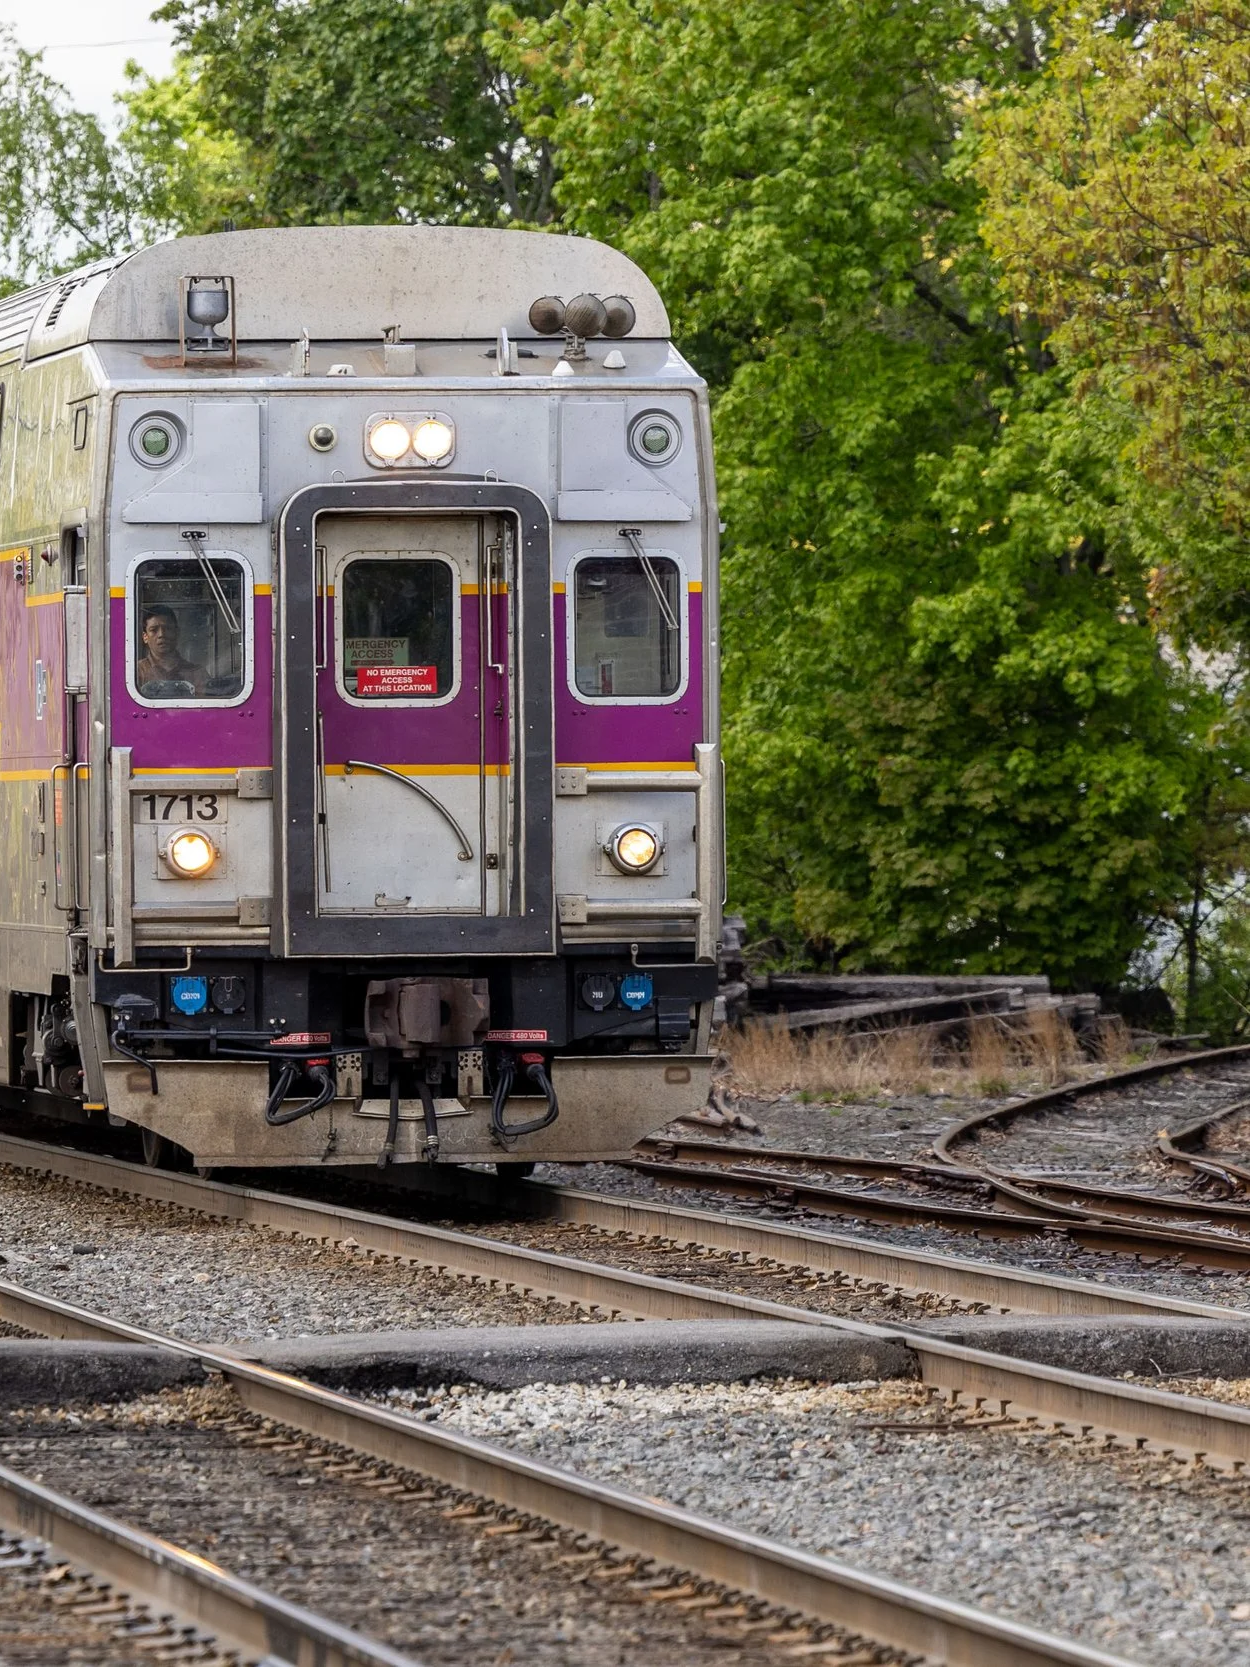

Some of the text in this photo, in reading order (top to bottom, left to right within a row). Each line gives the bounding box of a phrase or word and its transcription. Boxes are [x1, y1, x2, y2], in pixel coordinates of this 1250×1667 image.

[346, 639, 406, 649] MERGENCY
[351, 649, 394, 659] ACCESS
[366, 668, 428, 676] NO EMERGENCY
[381, 676, 413, 684] ACCESS
[393, 684, 432, 692] LOCATION
[142, 794, 219, 821] 1713
